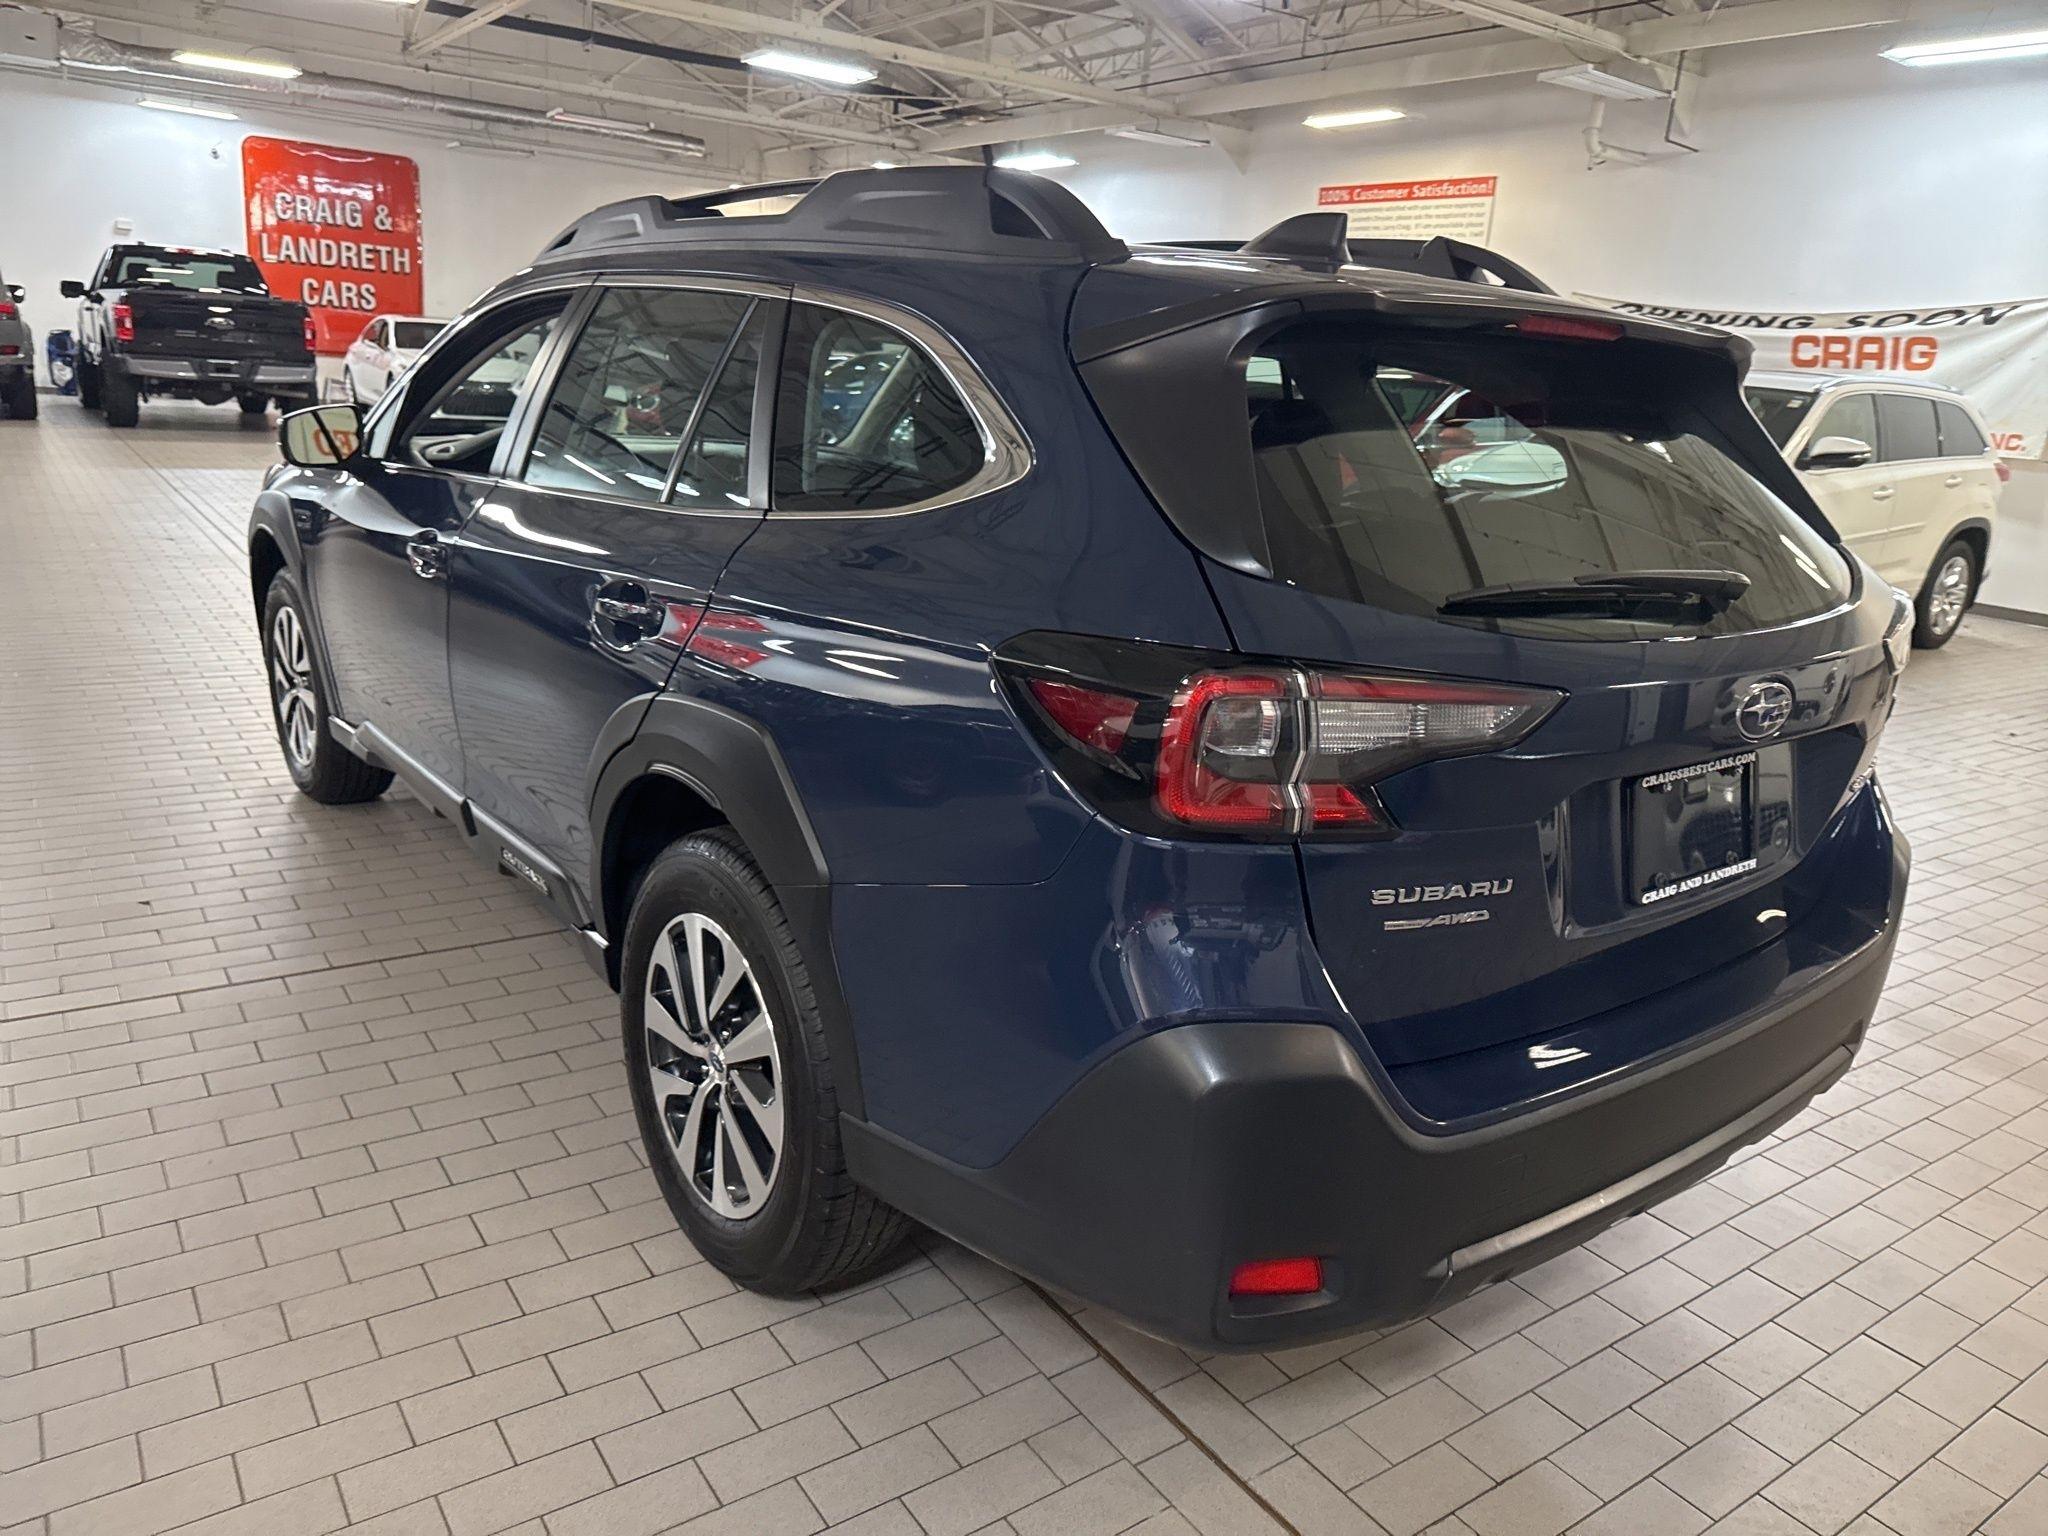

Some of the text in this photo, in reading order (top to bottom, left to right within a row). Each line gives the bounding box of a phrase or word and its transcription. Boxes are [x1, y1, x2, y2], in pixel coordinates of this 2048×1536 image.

[1321, 181, 1493, 203] 100% Customer Satisfaction!
[274, 191, 394, 231] CRAIG &
[260, 232, 412, 274] LANDRETH
[301, 277, 377, 311] CARS
[1836, 304, 2023, 330] SOON
[1790, 334, 1940, 372] CRAIG
[1641, 751, 1756, 788] CRAIGSBESTCARS.COM
[1371, 878, 1514, 906] SUBARU
[1641, 858, 1758, 905] CRAIG AND LANDRETH
[1424, 909, 1491, 928] AWD
